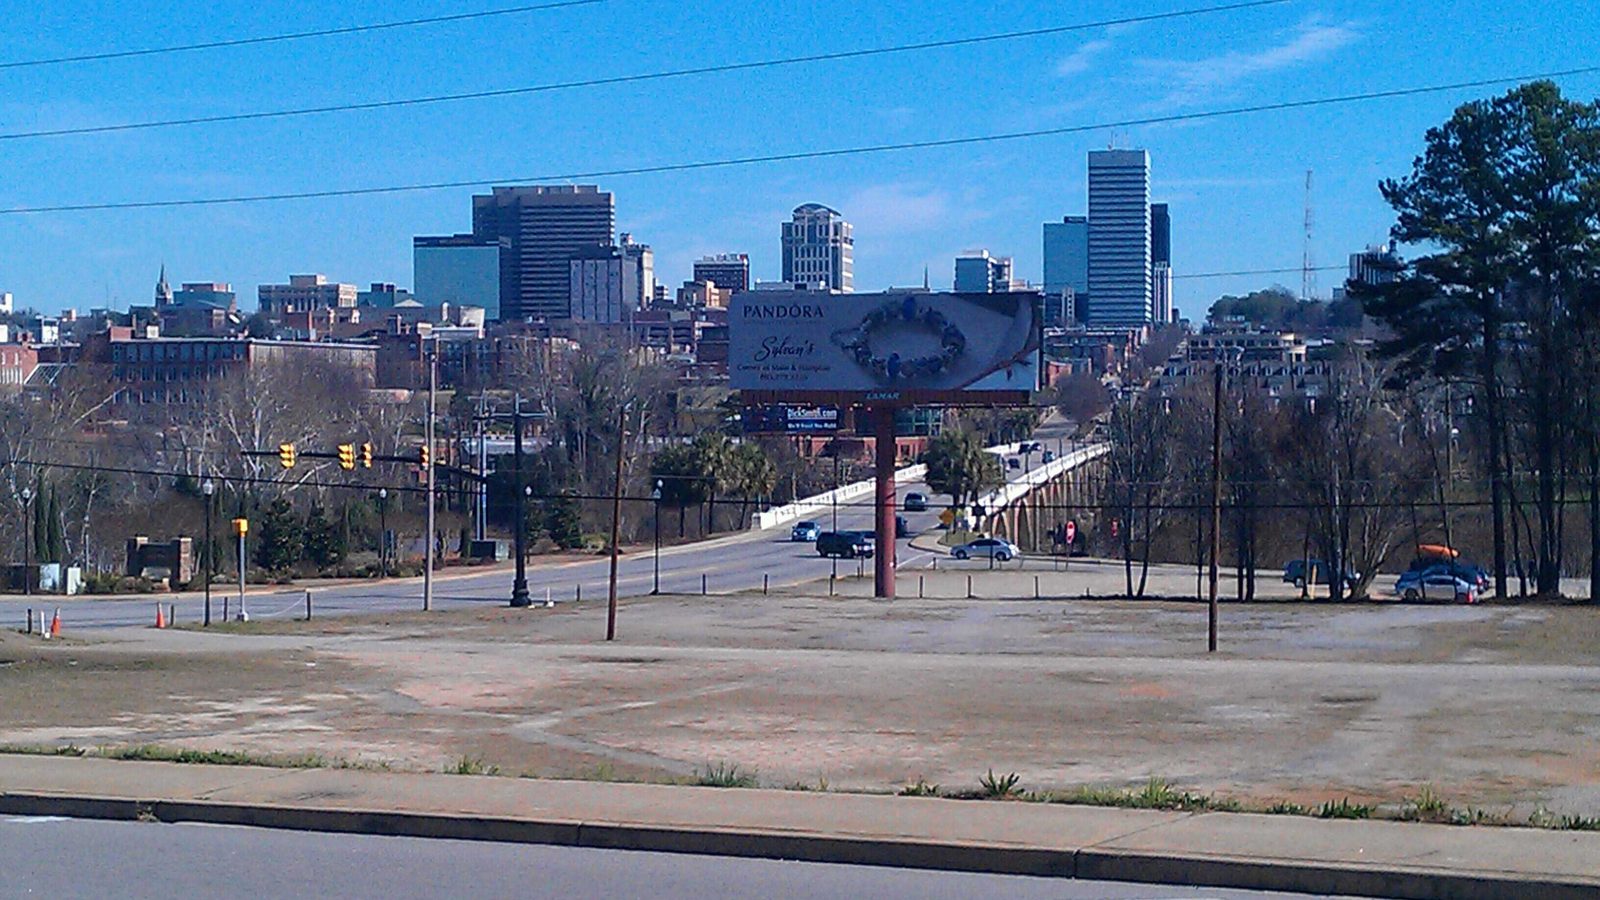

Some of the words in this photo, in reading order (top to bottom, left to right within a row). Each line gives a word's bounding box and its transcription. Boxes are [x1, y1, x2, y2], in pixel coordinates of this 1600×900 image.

[743, 304, 824, 318] PANDORA
[754, 335, 815, 362] Sylvan's
[866, 392, 900, 400] LAMAR
